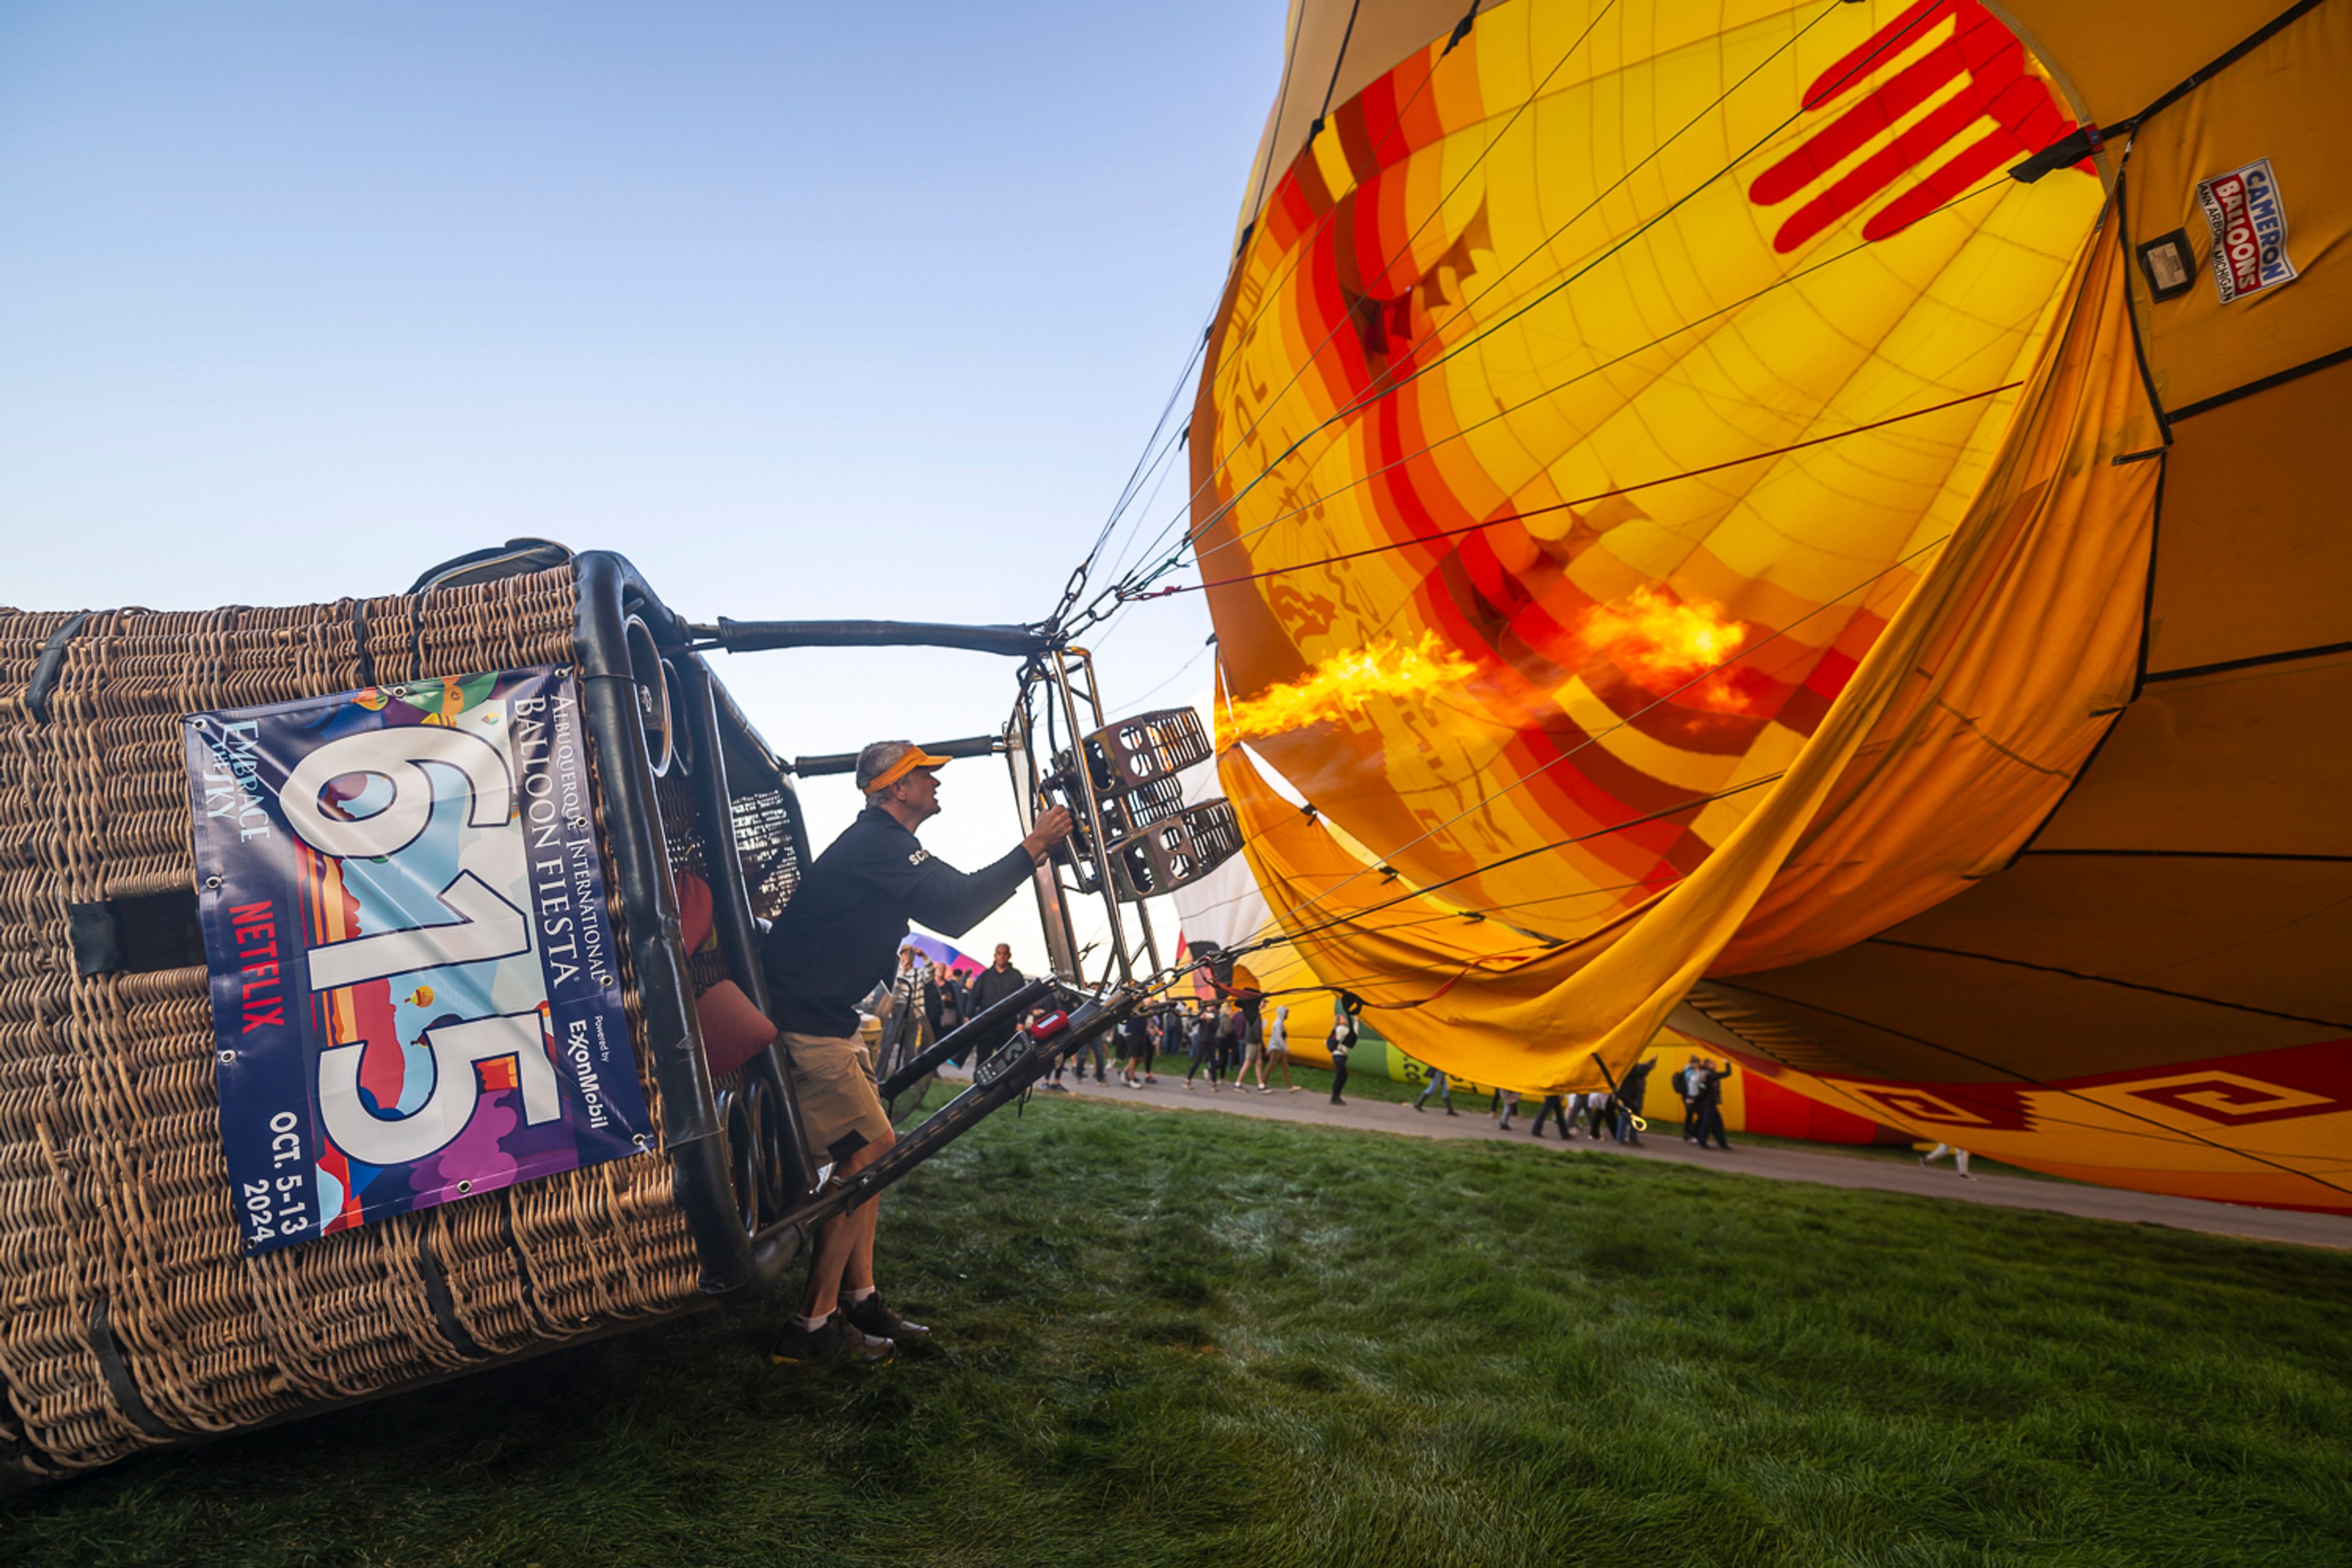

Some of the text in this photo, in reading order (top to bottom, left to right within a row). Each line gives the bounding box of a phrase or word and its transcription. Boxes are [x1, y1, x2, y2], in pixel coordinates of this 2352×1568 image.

[2198, 183, 2215, 206] ANN
[2213, 249, 2234, 303] MICHIGAN
[2215, 179, 2256, 290] BALLOONS
[2246, 170, 2286, 282] CAMERON
[202, 742, 237, 820] THE SKY
[222, 720, 271, 843] EMBRACE
[551, 695, 606, 980] ALBUQUERQUE INTERNATIONAL
[514, 695, 579, 989] BALLOON FIESTA
[228, 900, 285, 1035] NETFLIX
[279, 724, 561, 1165] 615
[594, 1014, 610, 1063] Powered by
[243, 1179, 276, 1243] 2024
[269, 1111, 309, 1235] OCT. 5-13
